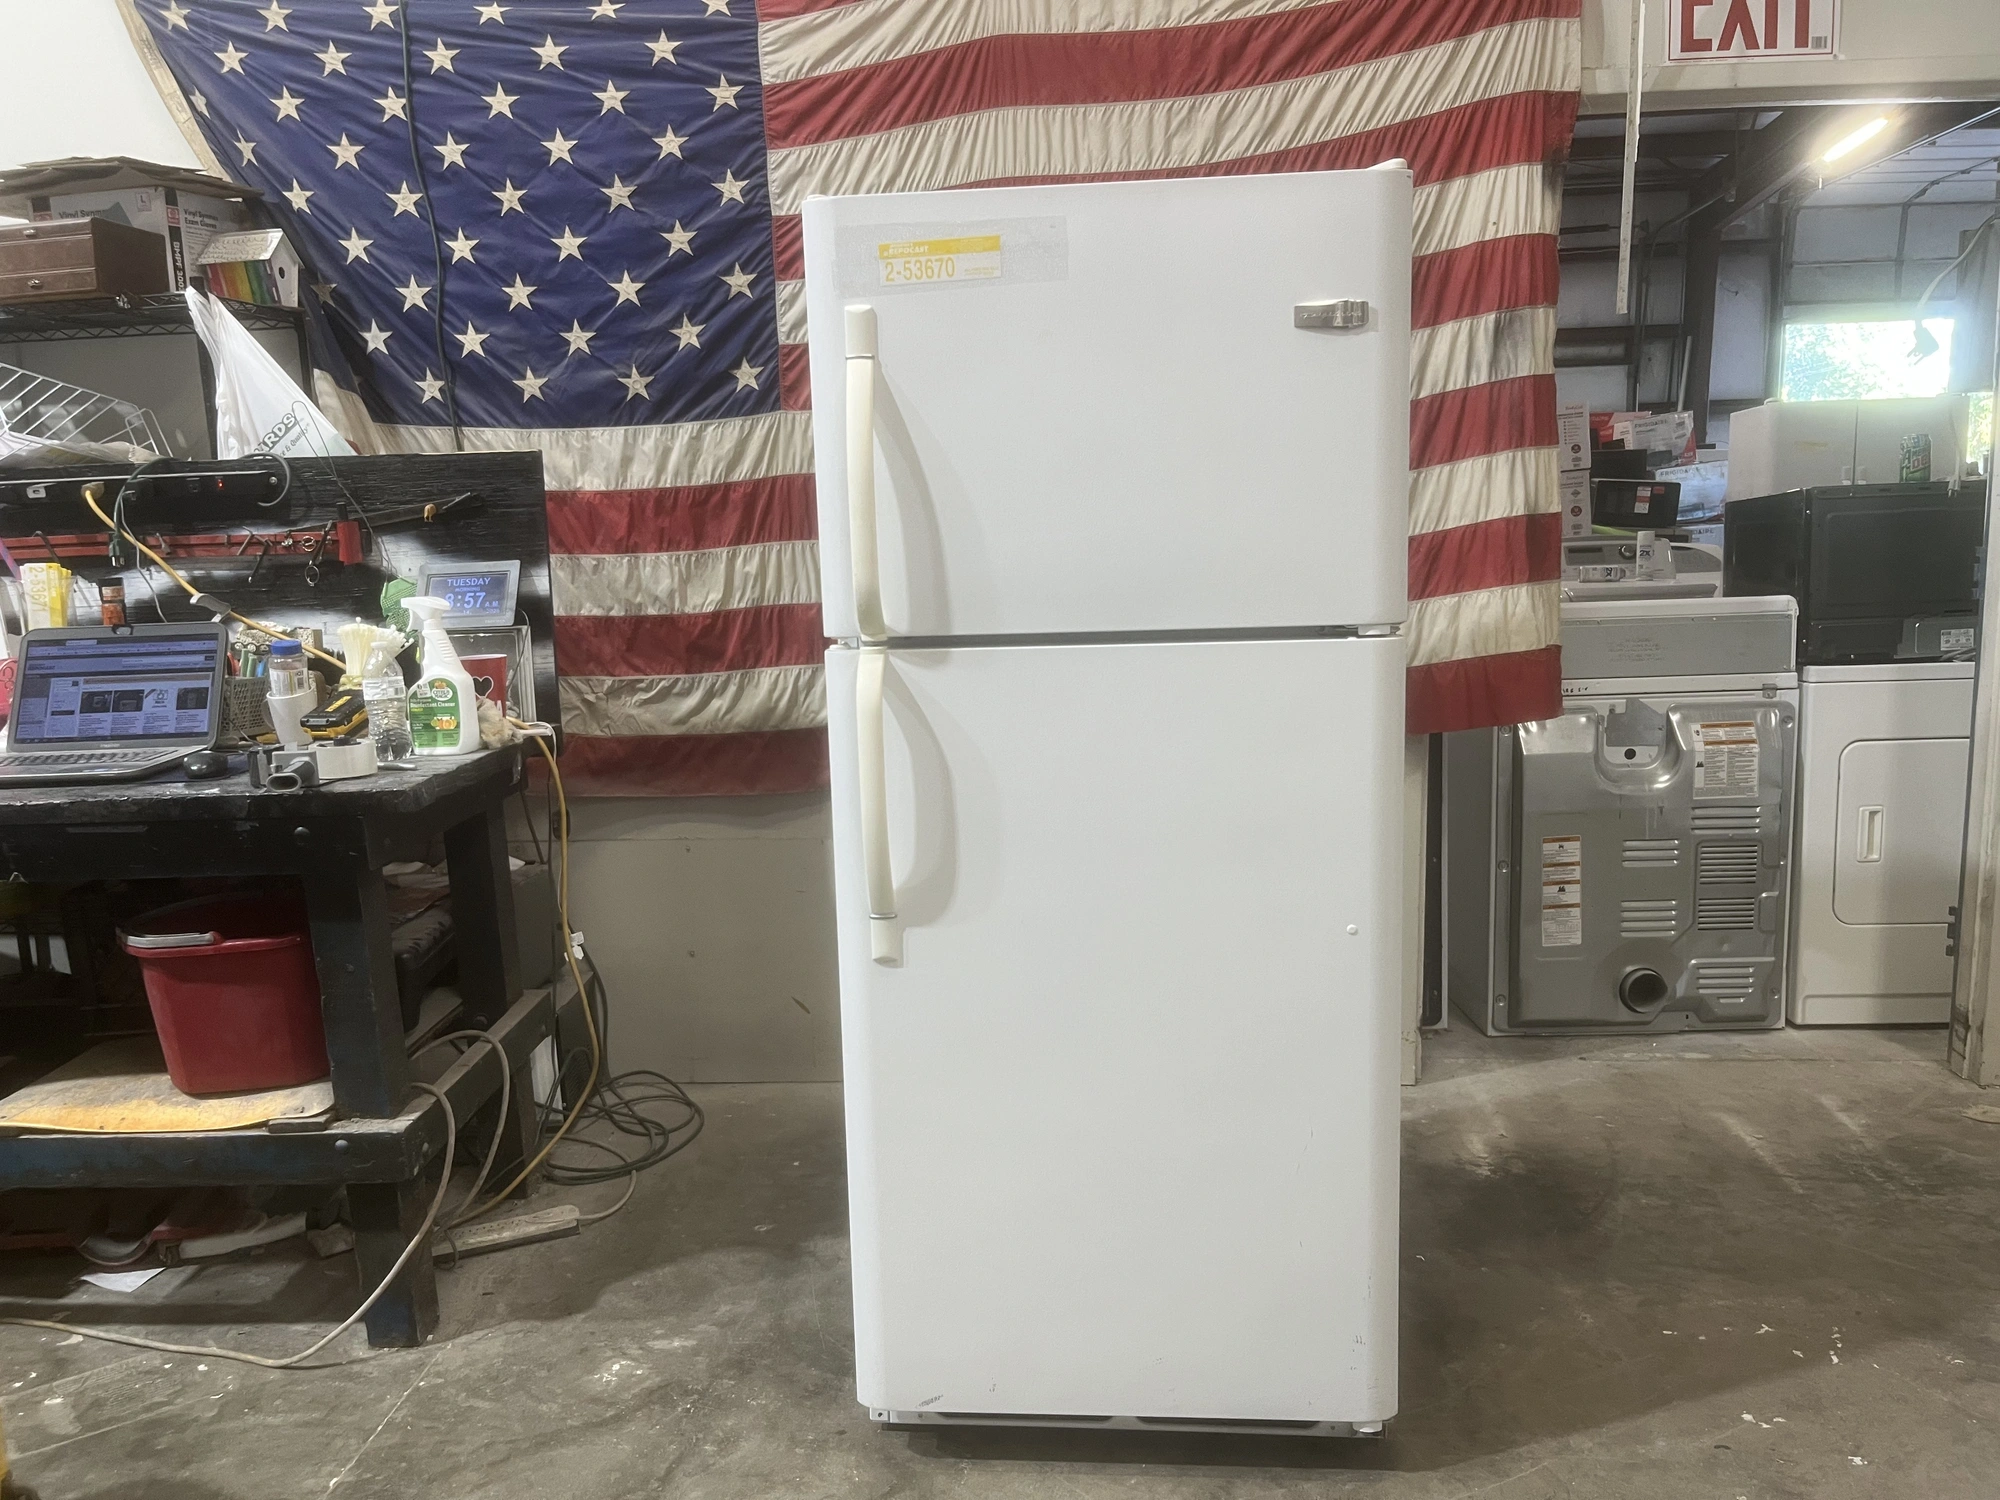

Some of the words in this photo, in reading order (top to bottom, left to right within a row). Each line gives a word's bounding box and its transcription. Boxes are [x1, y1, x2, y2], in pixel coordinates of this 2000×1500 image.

[80, 209, 104, 218] Synm
[184, 208, 198, 218] Vinyl
[185, 217, 199, 226] Exam
[885, 257, 955, 282] 2-53670
[254, 413, 297, 452] RDS
[1660, 467, 1695, 476] FRIGIDAI
[1639, 549, 1651, 557] 2X
[447, 577, 491, 587] TUESDAY
[445, 591, 486, 609] 8:57
